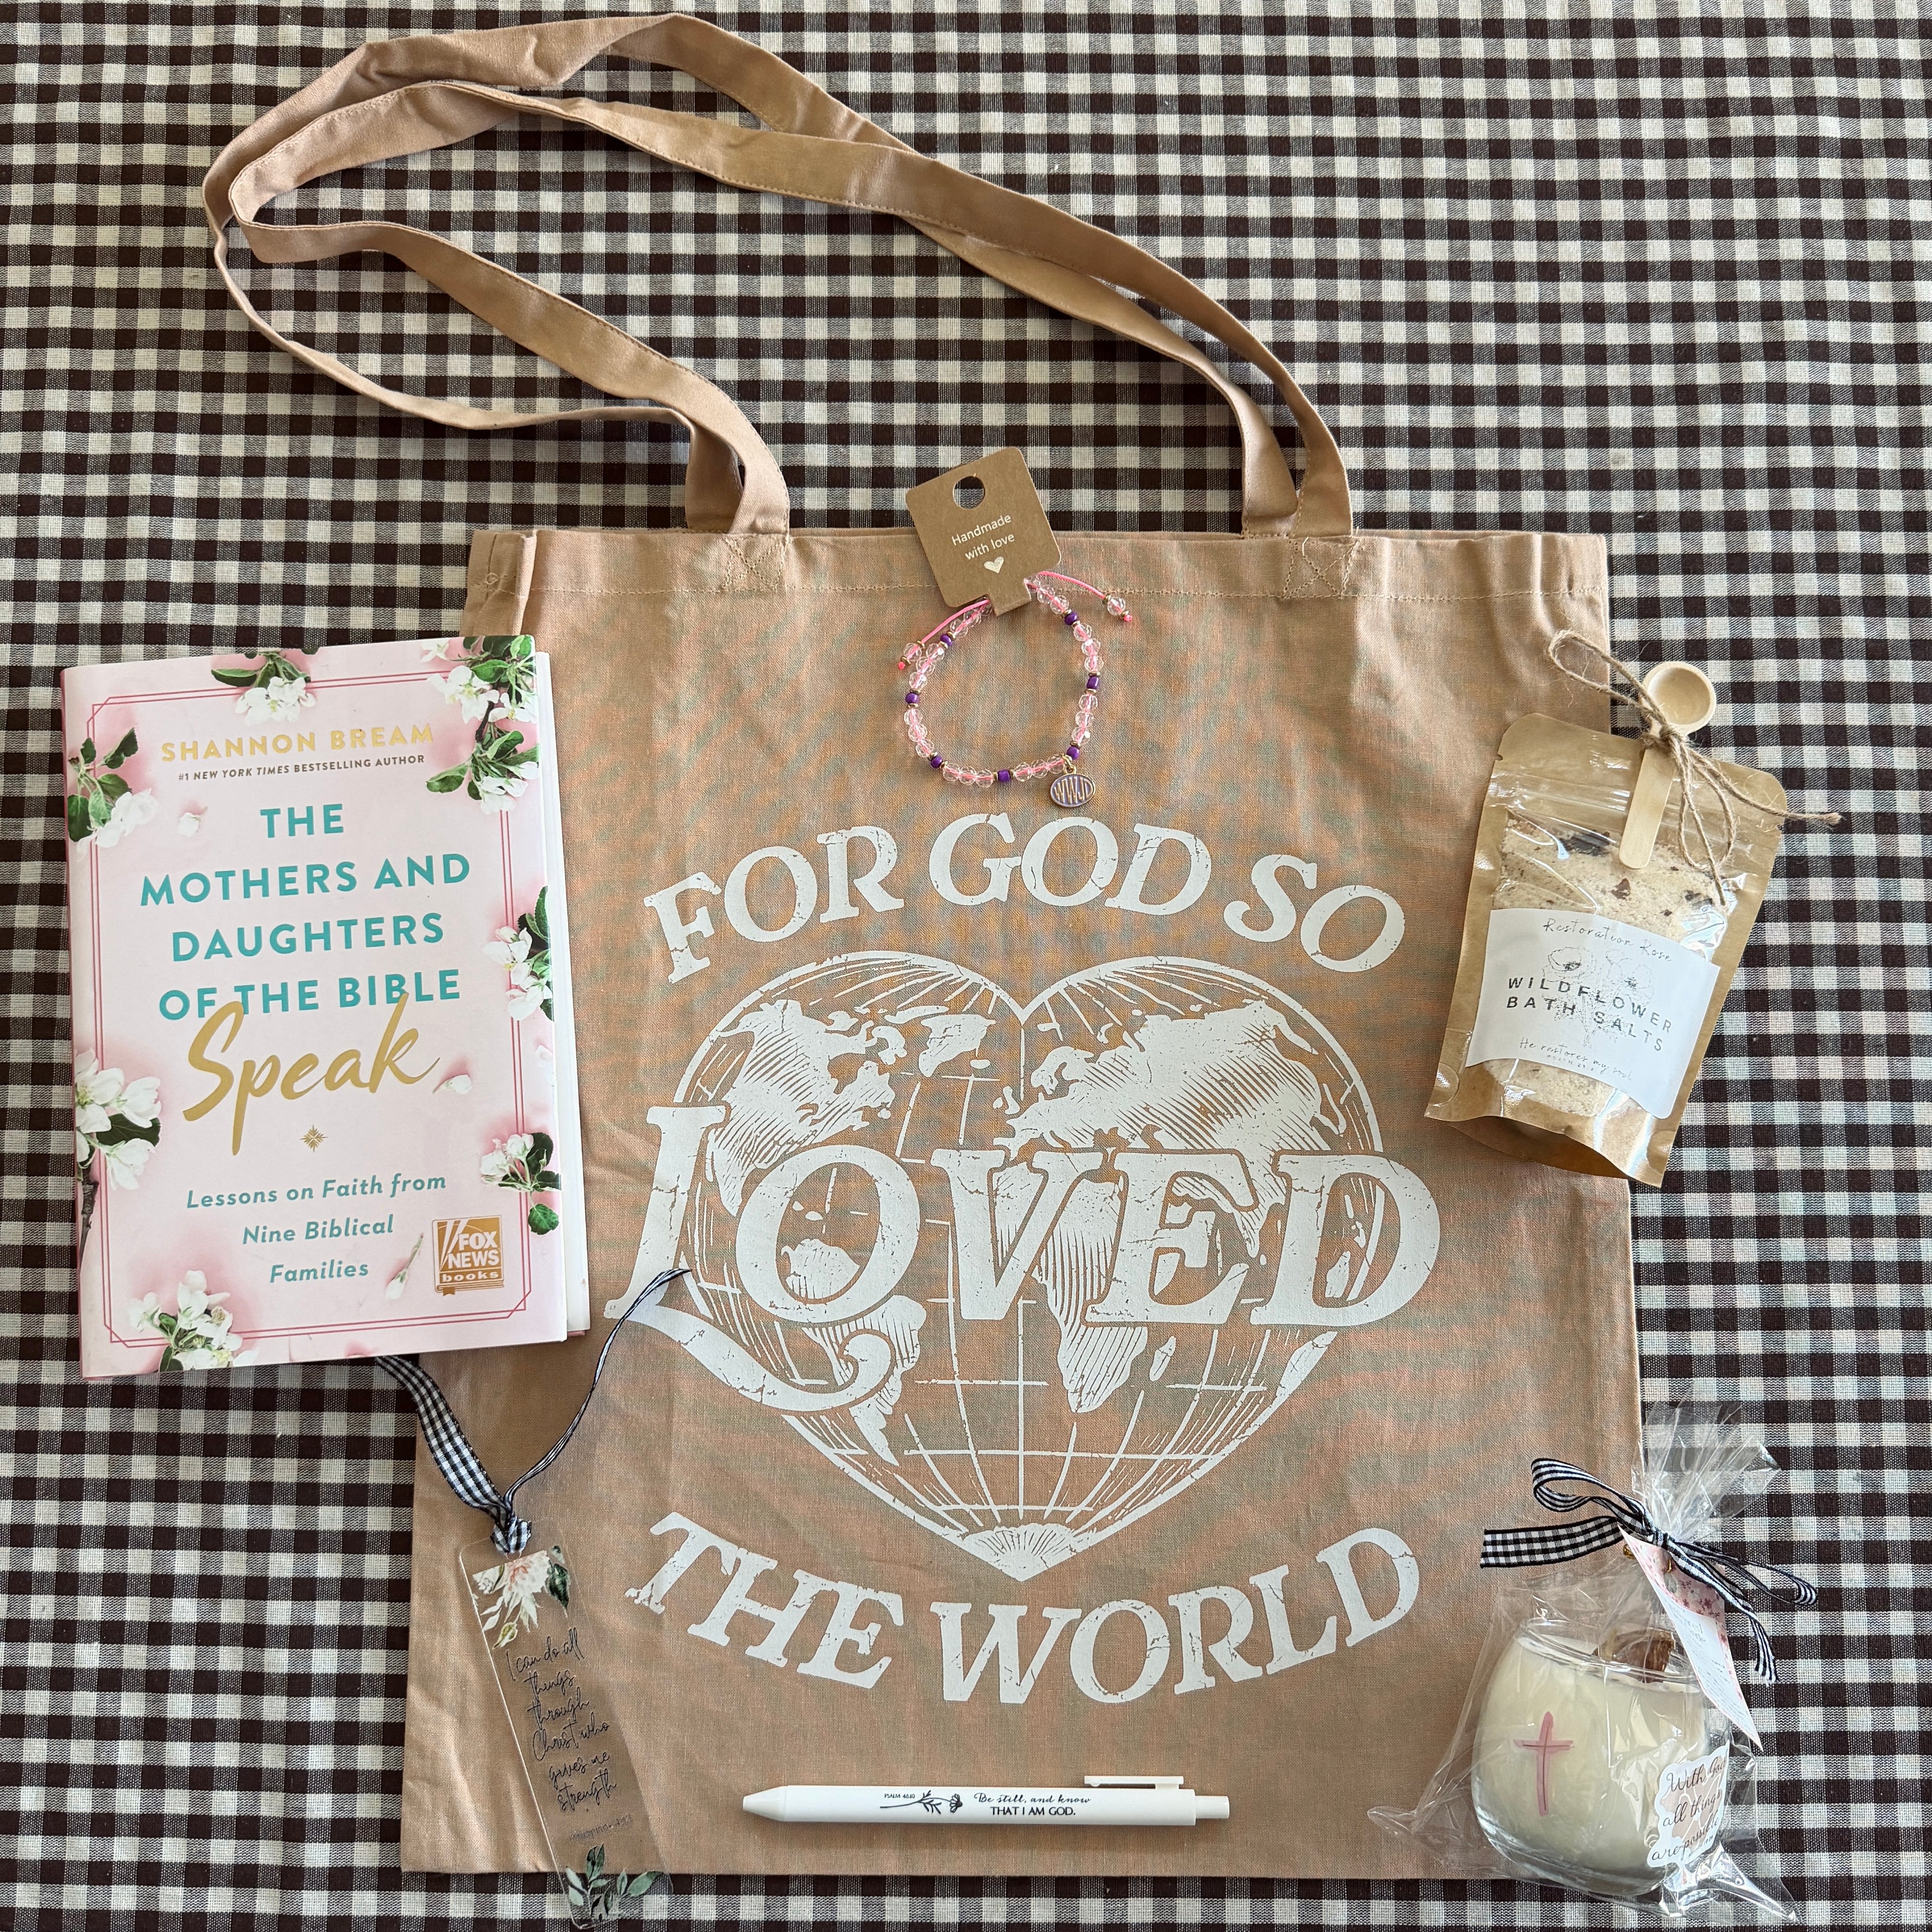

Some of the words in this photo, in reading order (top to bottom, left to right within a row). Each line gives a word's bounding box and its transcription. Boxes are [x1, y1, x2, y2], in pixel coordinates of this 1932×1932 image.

[951, 515, 1011, 546] Handmade
[965, 543, 990, 560] with
[991, 534, 1015, 549] love
[161, 732, 315, 762] SHANNON
[331, 723, 434, 750] BREAM
[179, 773, 189, 782] #1
[193, 770, 218, 780] NEW
[222, 768, 253, 778] YORK
[257, 765, 290, 775] TIMES
[294, 759, 372, 773] BESTSELLING
[375, 755, 425, 767] AUTHOR
[1054, 776, 1093, 804] WWJD
[260, 803, 344, 839] THE
[140, 861, 359, 907] MOTHERS
[374, 853, 471, 890] AND
[643, 825, 904, 984] FOR
[929, 813, 1211, 916] GOD
[1224, 853, 1405, 974] SO
[173, 913, 444, 963] DAUGHTERS
[1640, 939, 1672, 962] Rose
[159, 989, 217, 1021] OF
[235, 980, 318, 1015] THE
[339, 969, 460, 1008] BIBLE
[1508, 977, 1672, 1033] WILDFLOWER
[1506, 996, 1576, 1016] BATH
[1594, 1011, 1663, 1052] SALTS
[1520, 1037, 1536, 1049] He
[1541, 1043, 1588, 1061] restores
[182, 991, 440, 1156] Speak
[187, 1188, 277, 1209] Lessons
[286, 1184, 314, 1201] on
[322, 1174, 384, 1199] Faith
[389, 1172, 447, 1198] from
[242, 1226, 296, 1245] Nine
[305, 1215, 394, 1240] Biblical
[458, 1231, 498, 1251] FOX
[269, 1261, 369, 1284] Families
[448, 1249, 500, 1269] NEWS
[604, 1104, 1441, 1412] LOVED
[442, 1271, 499, 1282] books
[624, 1511, 904, 1689] THE
[930, 1527, 1421, 1705] WORLD
[516, 1655, 541, 1673] can
[544, 1636, 559, 1663] do
[564, 1627, 585, 1660] all
[524, 1669, 576, 1700] things
[527, 1686, 589, 1730] through
[533, 1719, 579, 1761] Christ
[581, 1711, 609, 1740] who
[549, 1757, 588, 1790] gives
[557, 1767, 617, 1811] strength
[1666, 1764, 1707, 1792] With
[974, 1792, 994, 1803] Be
[996, 1794, 1027, 1804] still,
[1030, 1795, 1055, 1803] and
[1057, 1794, 1091, 1804] know
[990, 1806, 1020, 1816] THAT
[1022, 1806, 1025, 1816] I
[1028, 1806, 1045, 1816] AM
[1049, 1806, 1076, 1816] GOD.
[1662, 1801, 1688, 1827] all
[1690, 1788, 1722, 1818] things
[1651, 1844, 1679, 1861] are
